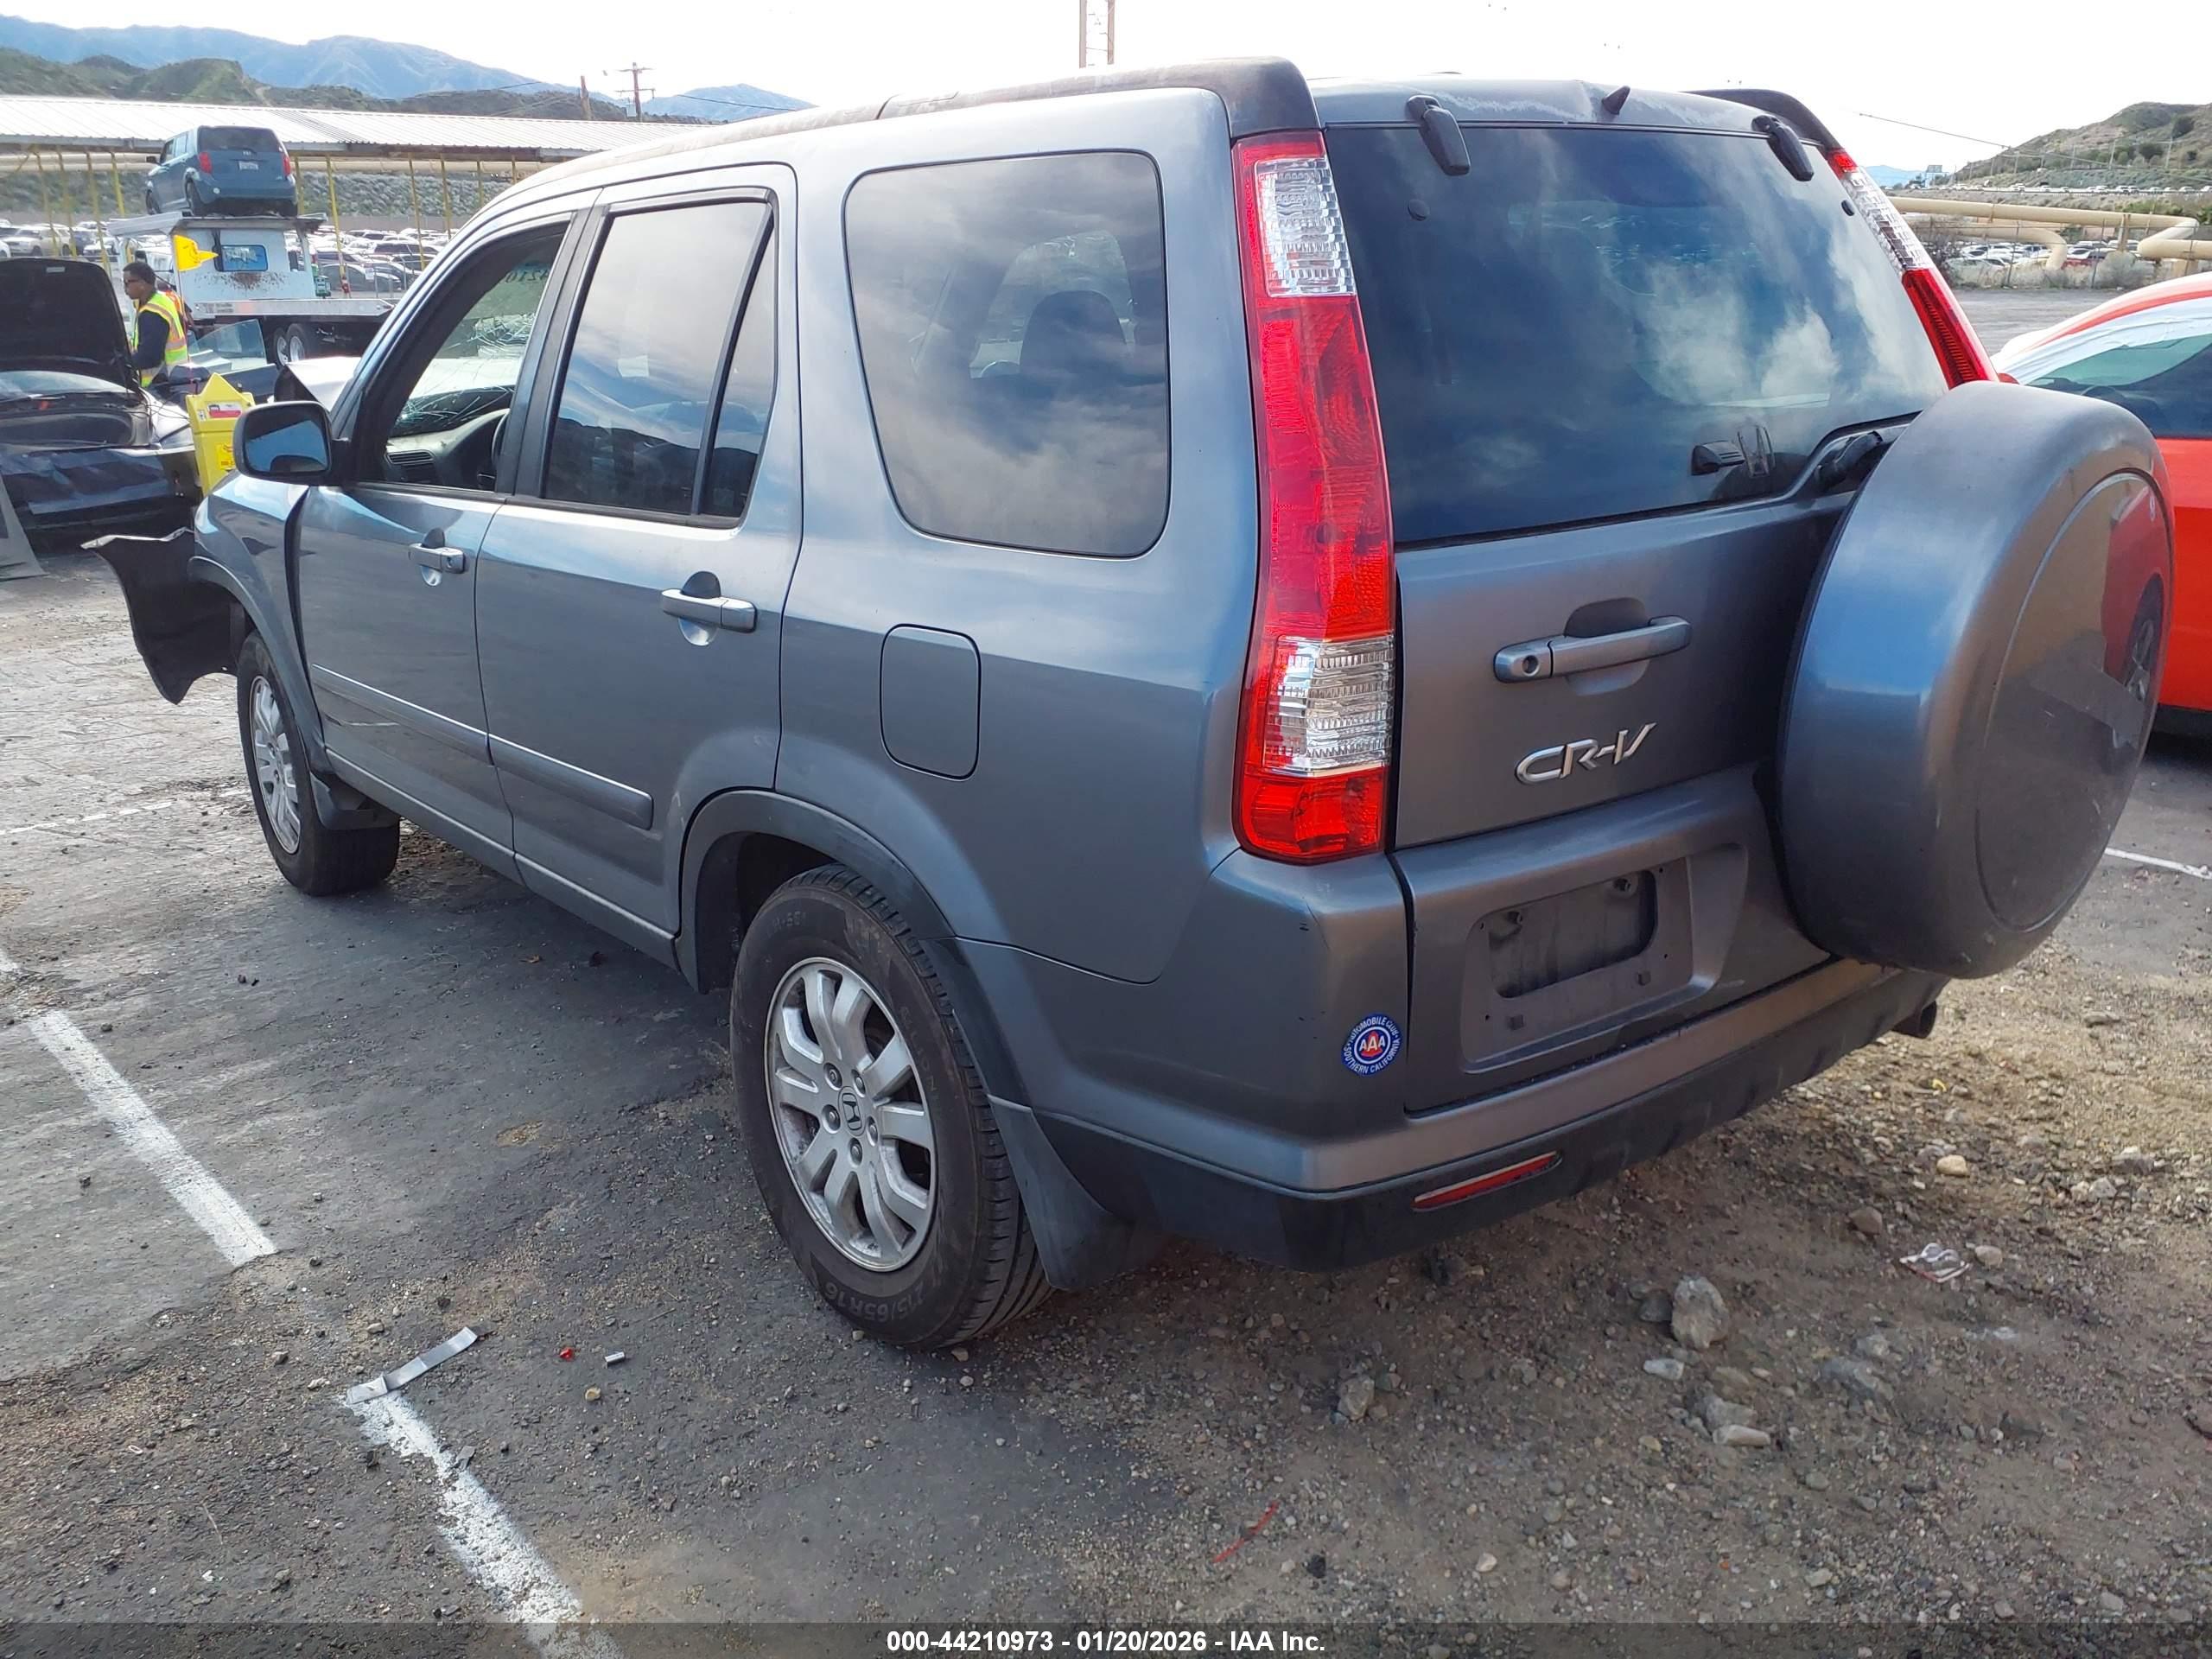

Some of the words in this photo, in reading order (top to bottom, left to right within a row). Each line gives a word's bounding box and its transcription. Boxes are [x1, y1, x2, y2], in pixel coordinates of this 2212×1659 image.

[1516, 722, 1657, 785] CR-V
[1350, 1016, 1388, 1043] AUTOMOBILE
[1386, 1020, 1399, 1036] CLUB
[1359, 1035, 1386, 1052] AAA
[1344, 1046, 1369, 1074] SOUTHERN
[1370, 1037, 1401, 1073] CALIFORNIA
